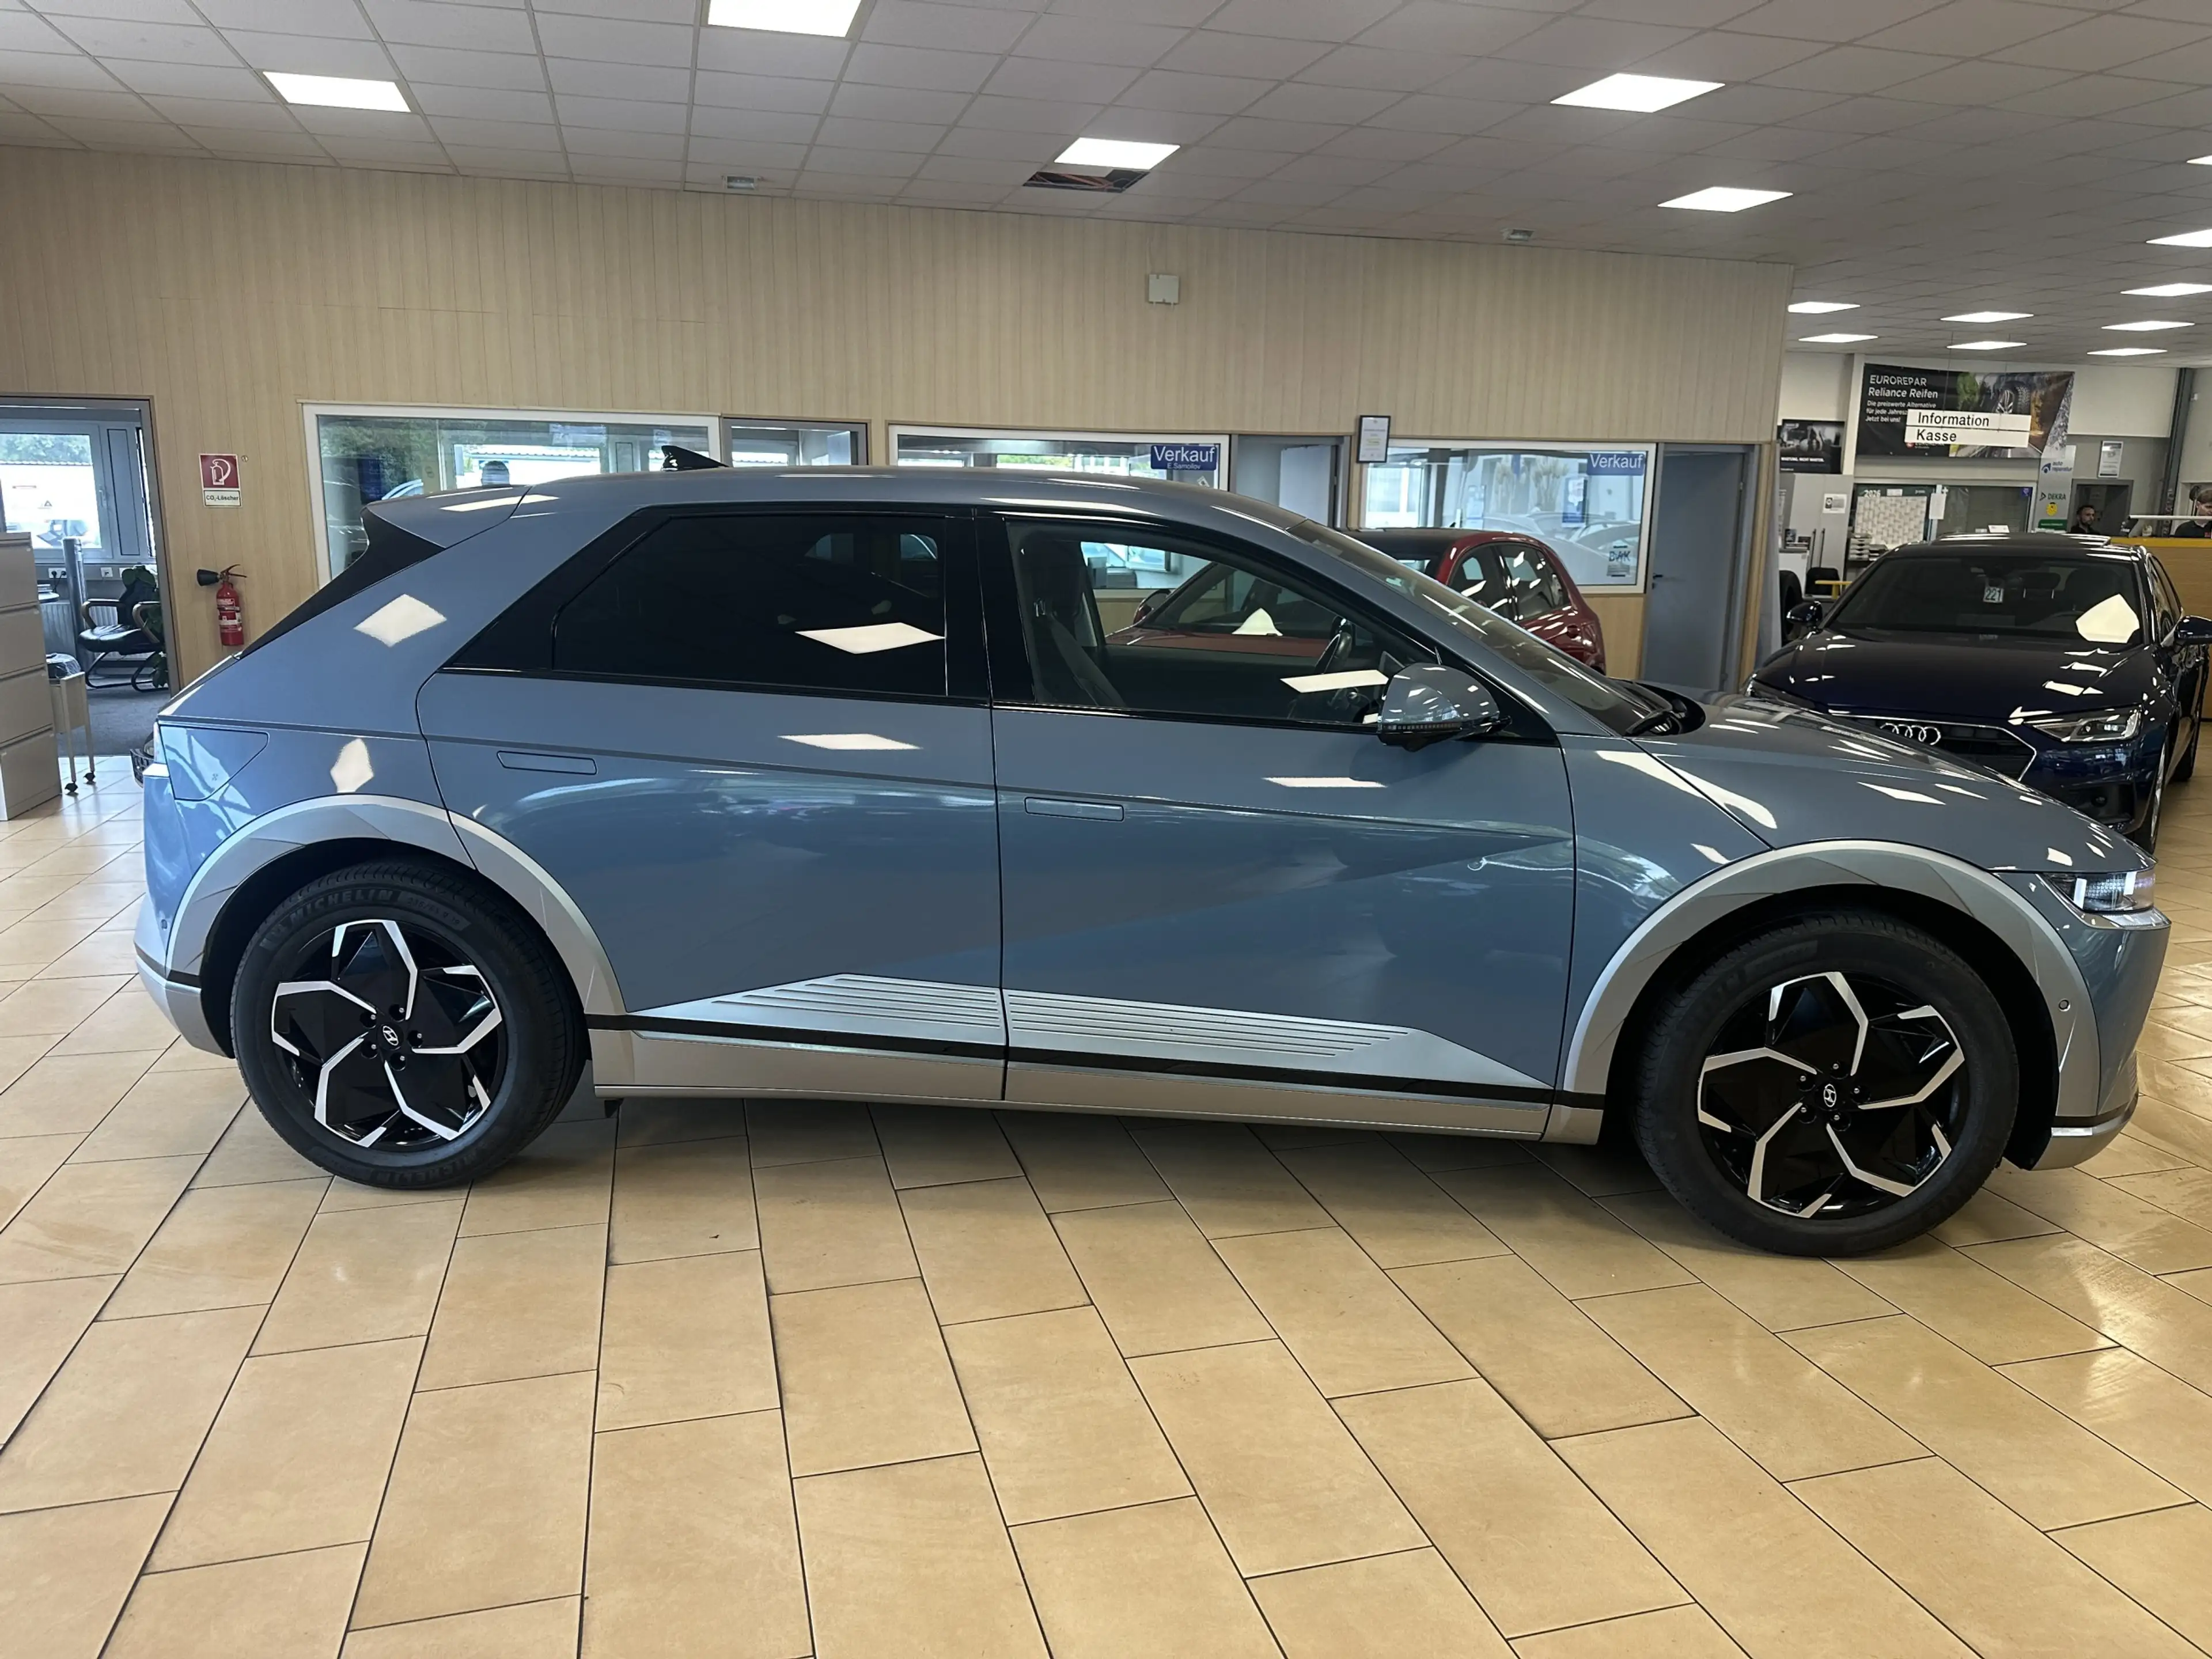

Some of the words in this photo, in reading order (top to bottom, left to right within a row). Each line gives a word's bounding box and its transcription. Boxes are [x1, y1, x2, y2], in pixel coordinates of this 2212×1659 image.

[1870, 375, 1927, 386] EUROREPAR
[1868, 387, 1907, 397] Reliance
[1910, 389, 1938, 399] Reifen
[1918, 412, 1990, 427] Information
[1916, 429, 1957, 442] Kasse
[1153, 446, 1215, 463] Verkauf
[1590, 453, 1643, 468] Verkauf
[1985, 588, 2001, 601] 221
[290, 889, 394, 926] MICHELIN
